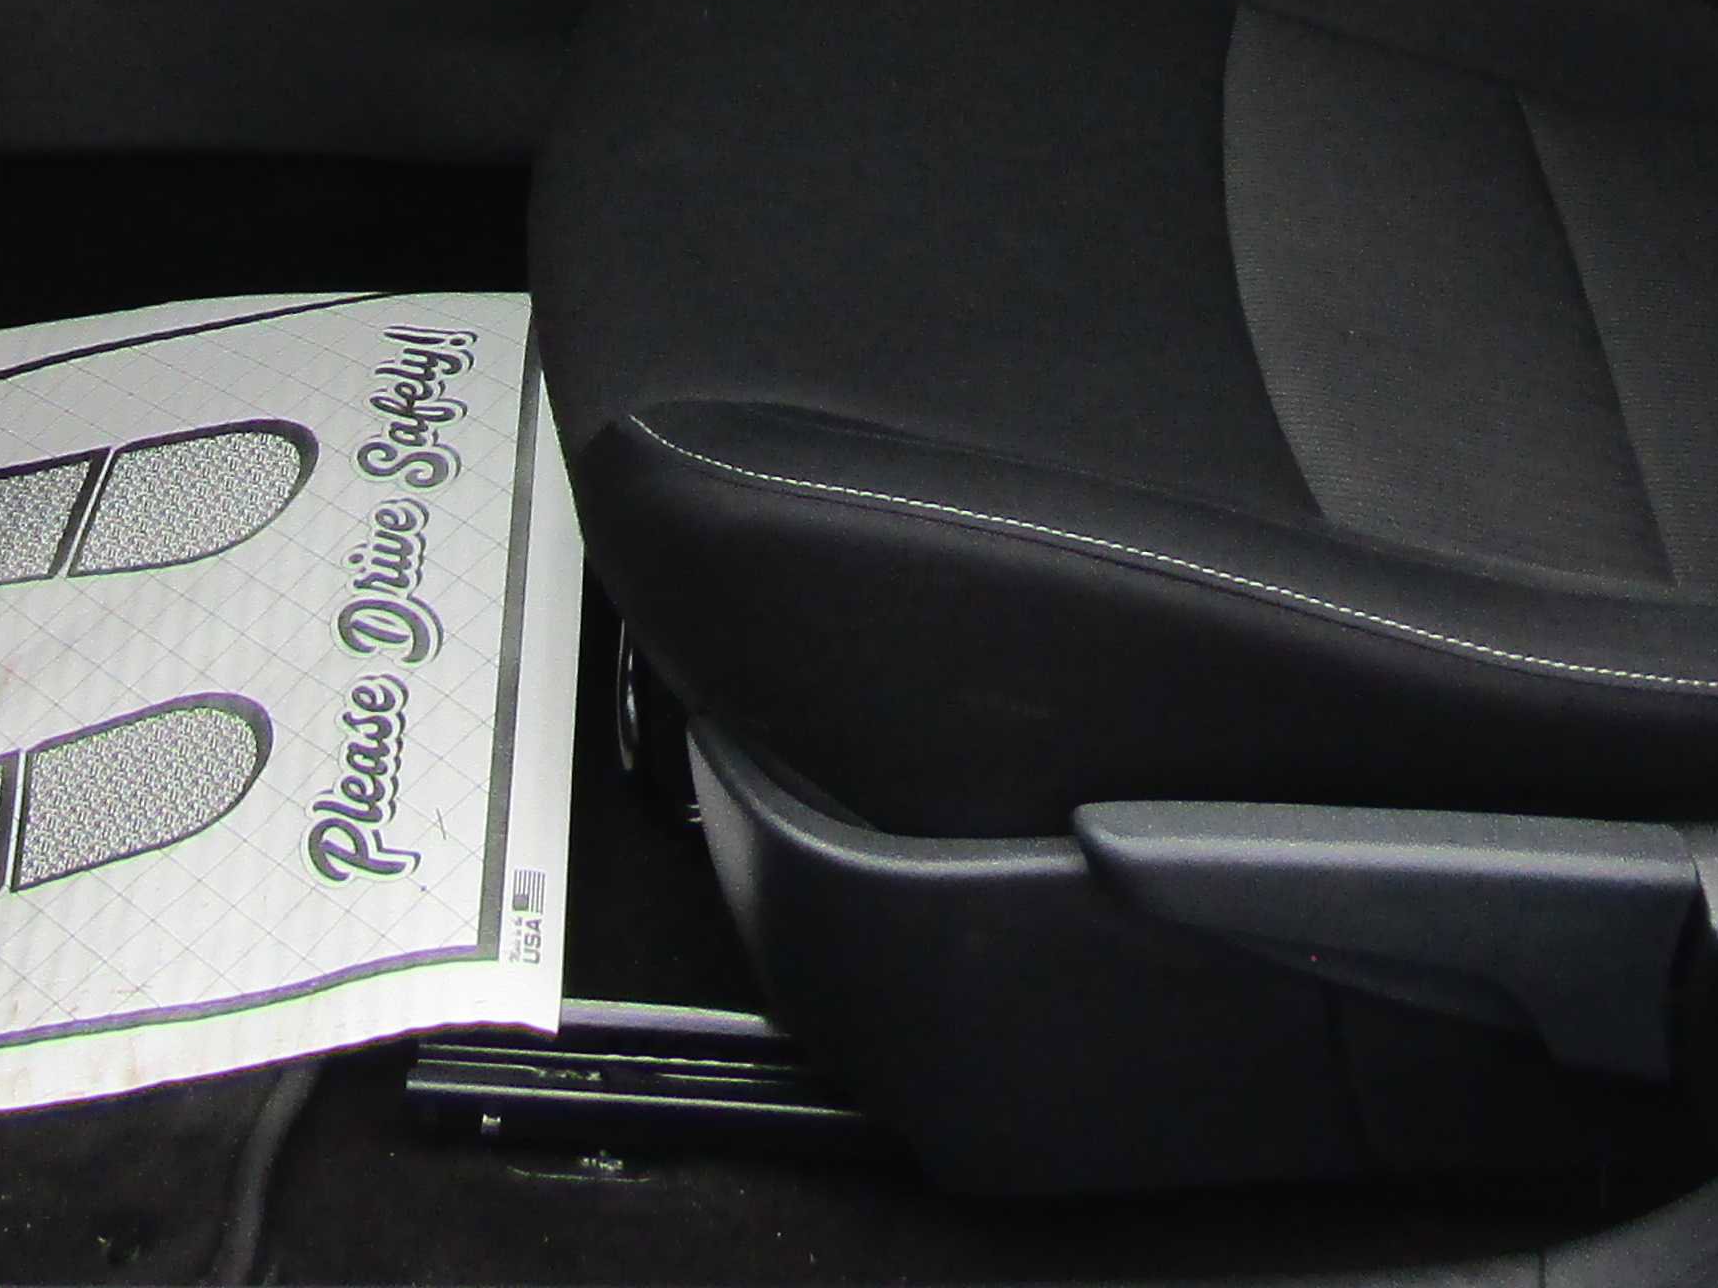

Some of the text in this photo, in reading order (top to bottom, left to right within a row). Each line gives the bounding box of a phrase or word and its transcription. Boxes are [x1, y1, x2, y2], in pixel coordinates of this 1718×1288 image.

[301, 324, 477, 885] Please Drive Safely!
[523, 919, 542, 965] USA
